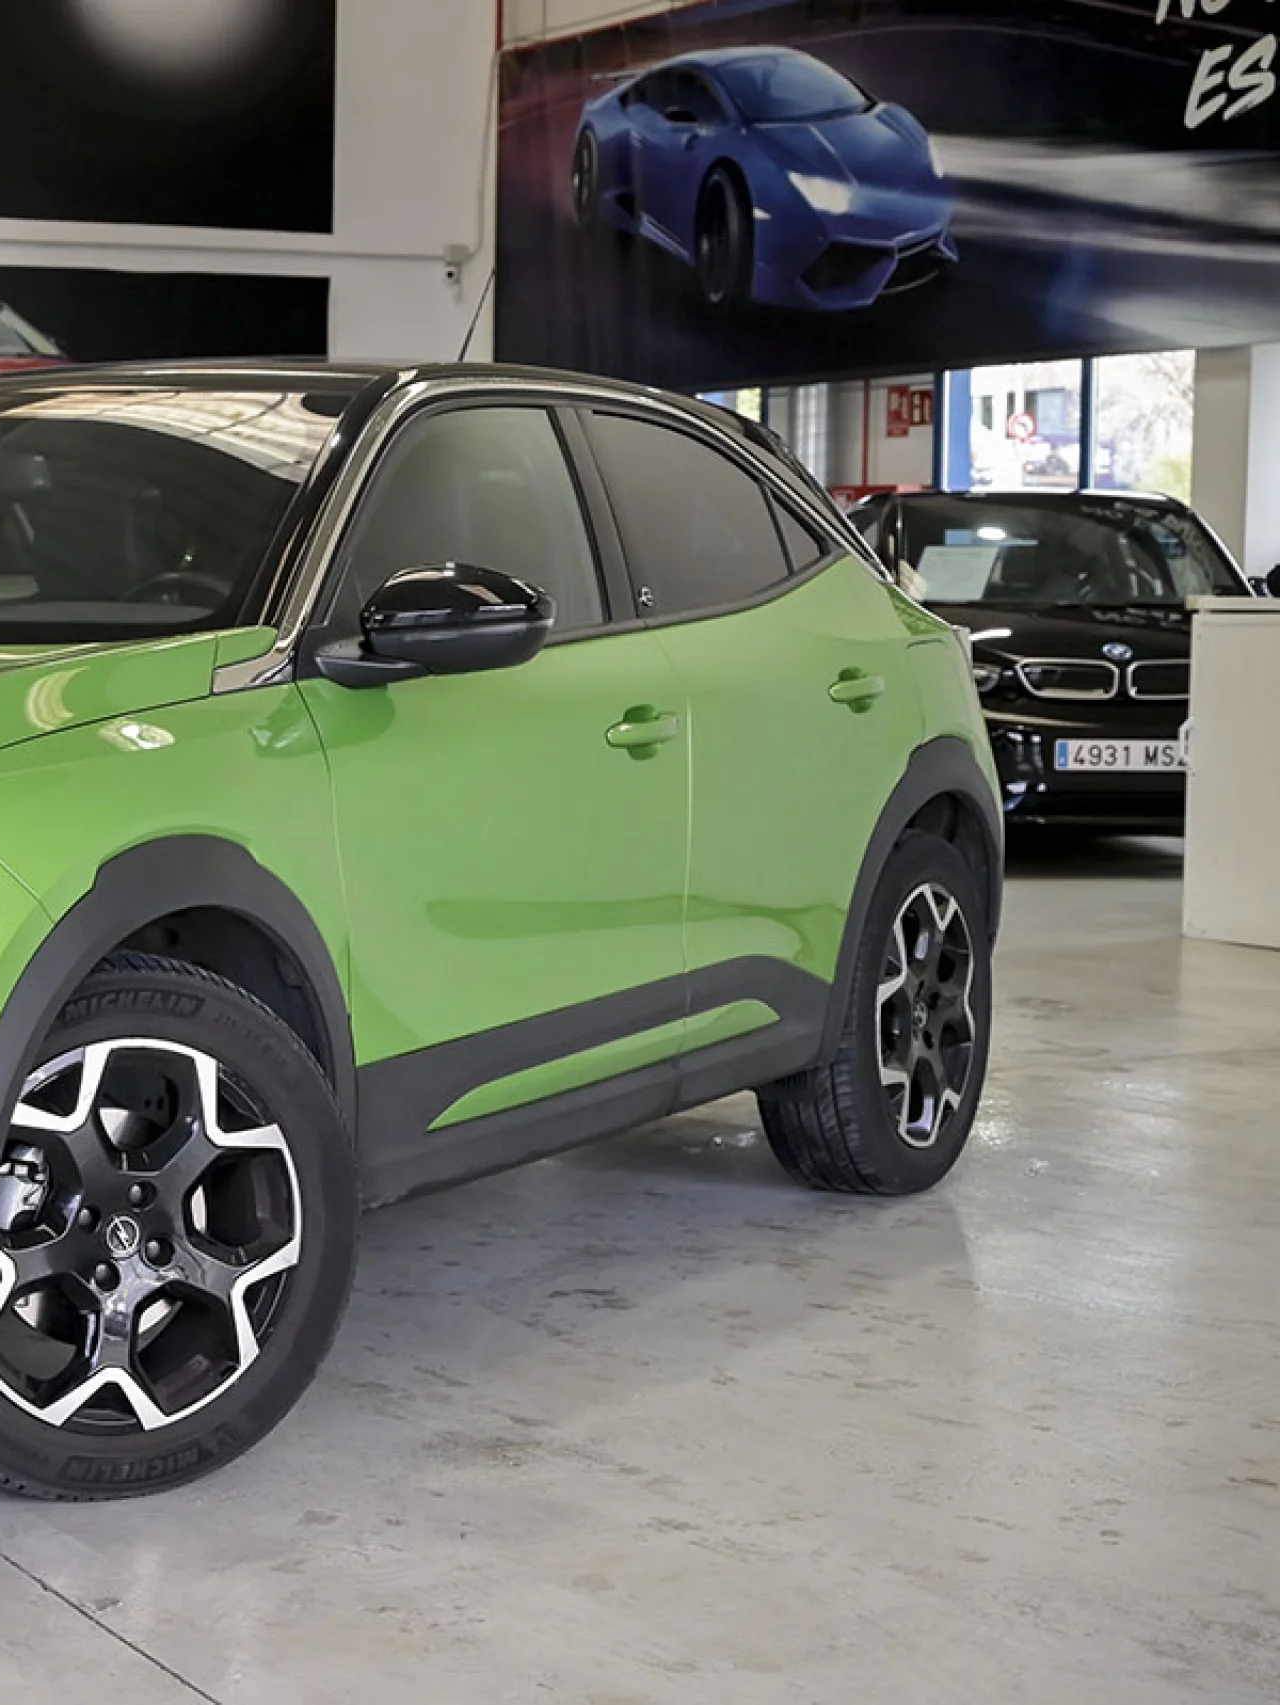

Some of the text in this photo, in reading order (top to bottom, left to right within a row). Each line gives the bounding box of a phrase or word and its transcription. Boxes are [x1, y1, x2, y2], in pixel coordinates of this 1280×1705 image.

[1184, 33, 1277, 129] ES
[1073, 743, 1132, 767] 4931
[65, 989, 198, 1022] MICHELIN
